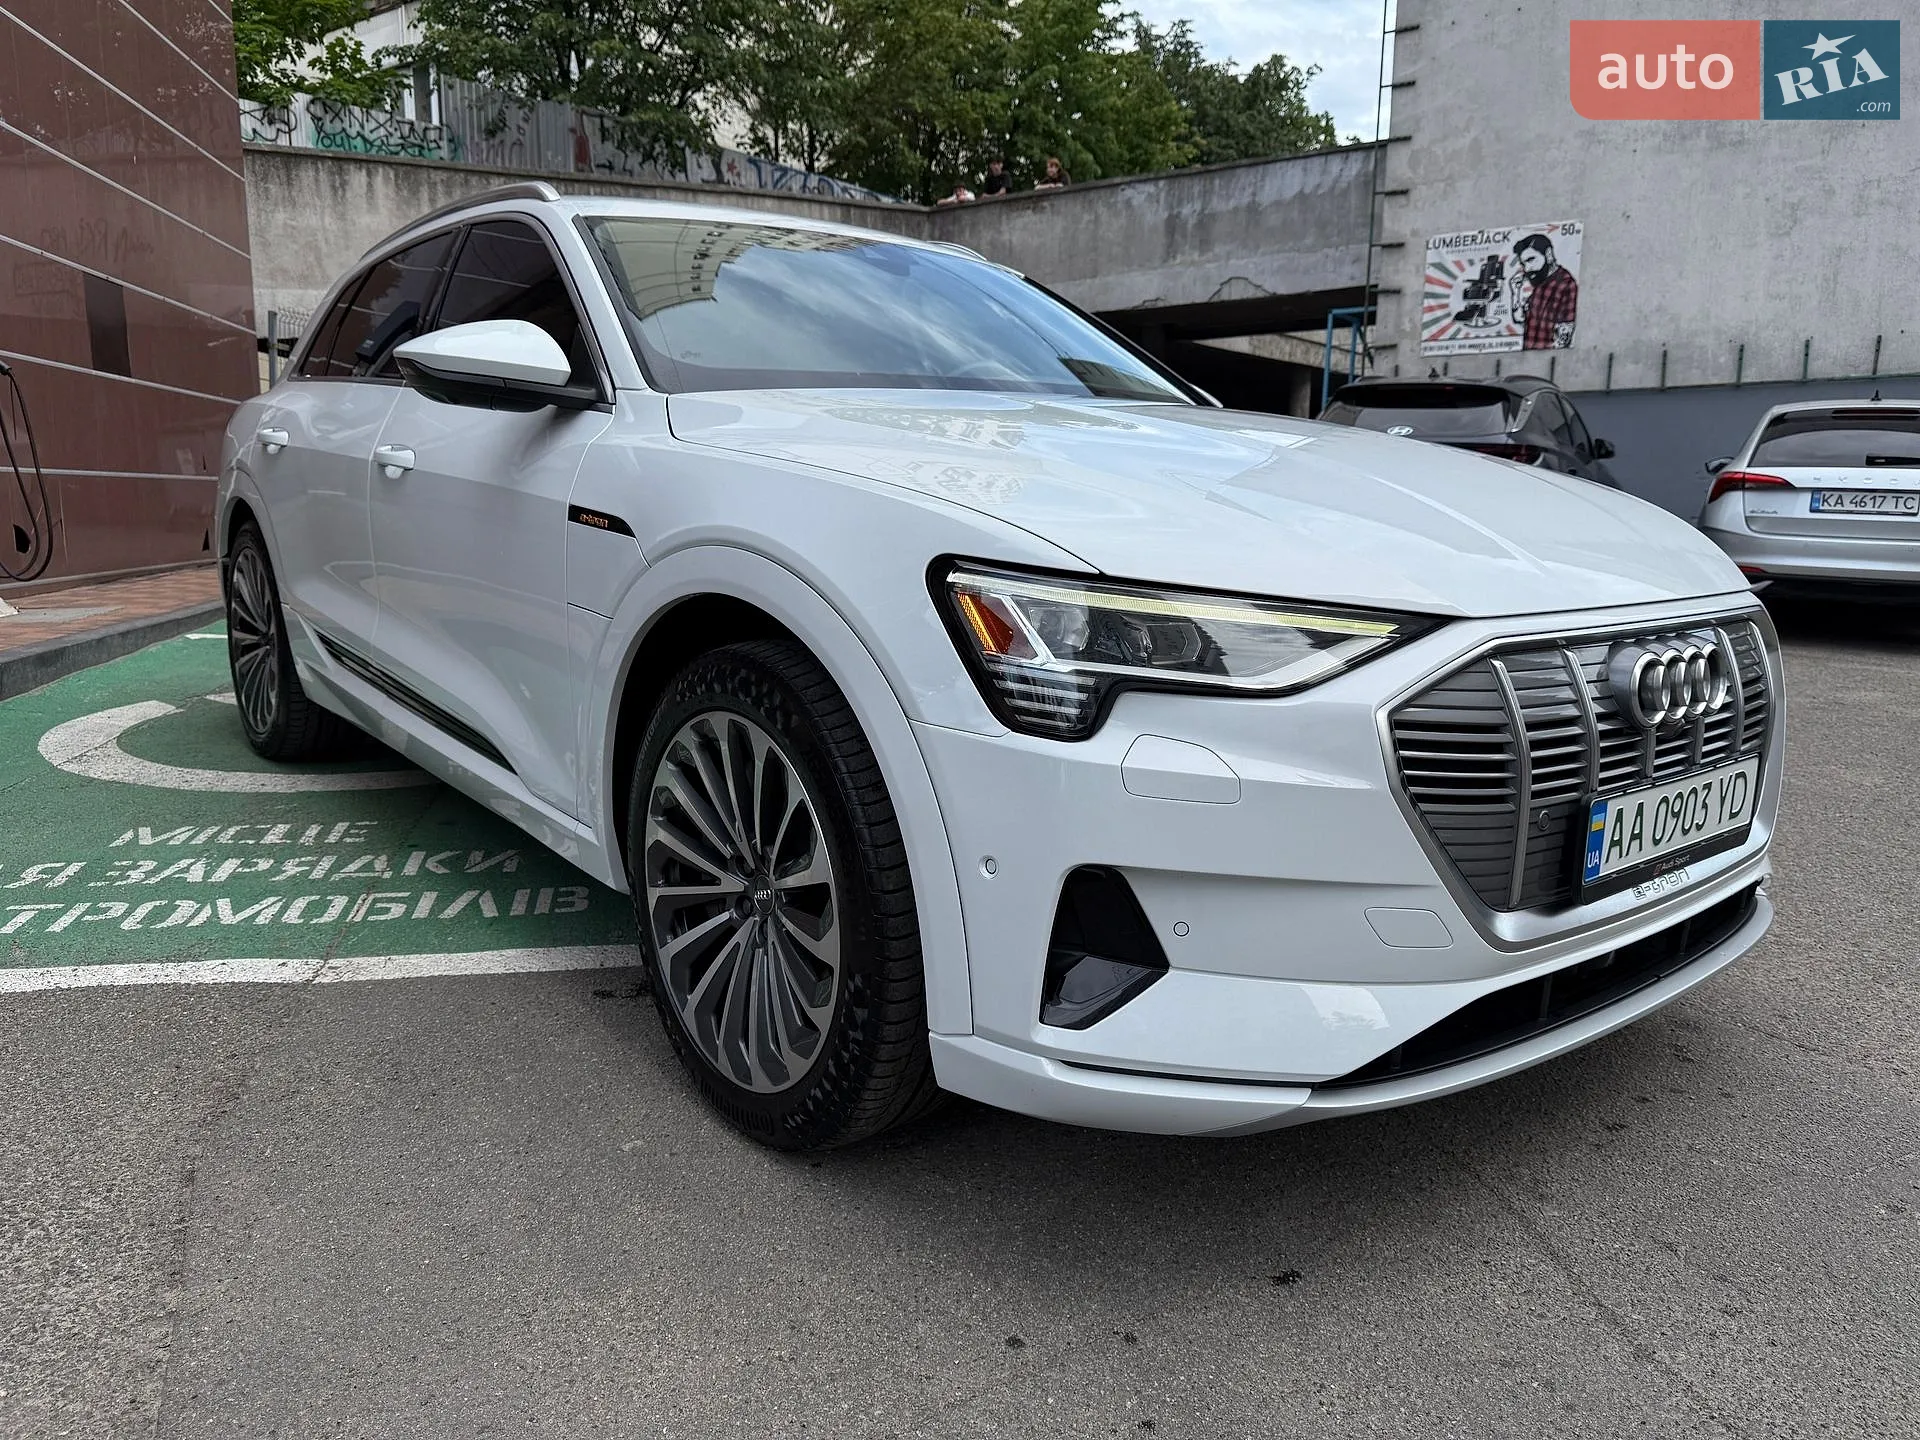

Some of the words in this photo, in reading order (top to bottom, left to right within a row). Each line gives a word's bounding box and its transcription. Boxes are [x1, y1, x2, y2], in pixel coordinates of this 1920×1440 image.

[1425, 230, 1512, 250] LUMBERJACK
[1821, 494, 1845, 507] KA
[1849, 494, 1887, 509] 4617
[1891, 495, 1916, 510] TC
[1604, 800, 1645, 864] AA
[1651, 779, 1713, 847] 0903
[1717, 769, 1749, 826] YD
[108, 821, 378, 848] МІСЦЕ
[0, 861, 87, 889] Я
[87, 850, 520, 888] ЗАРЯДКИ
[1587, 850, 1600, 869] UA
